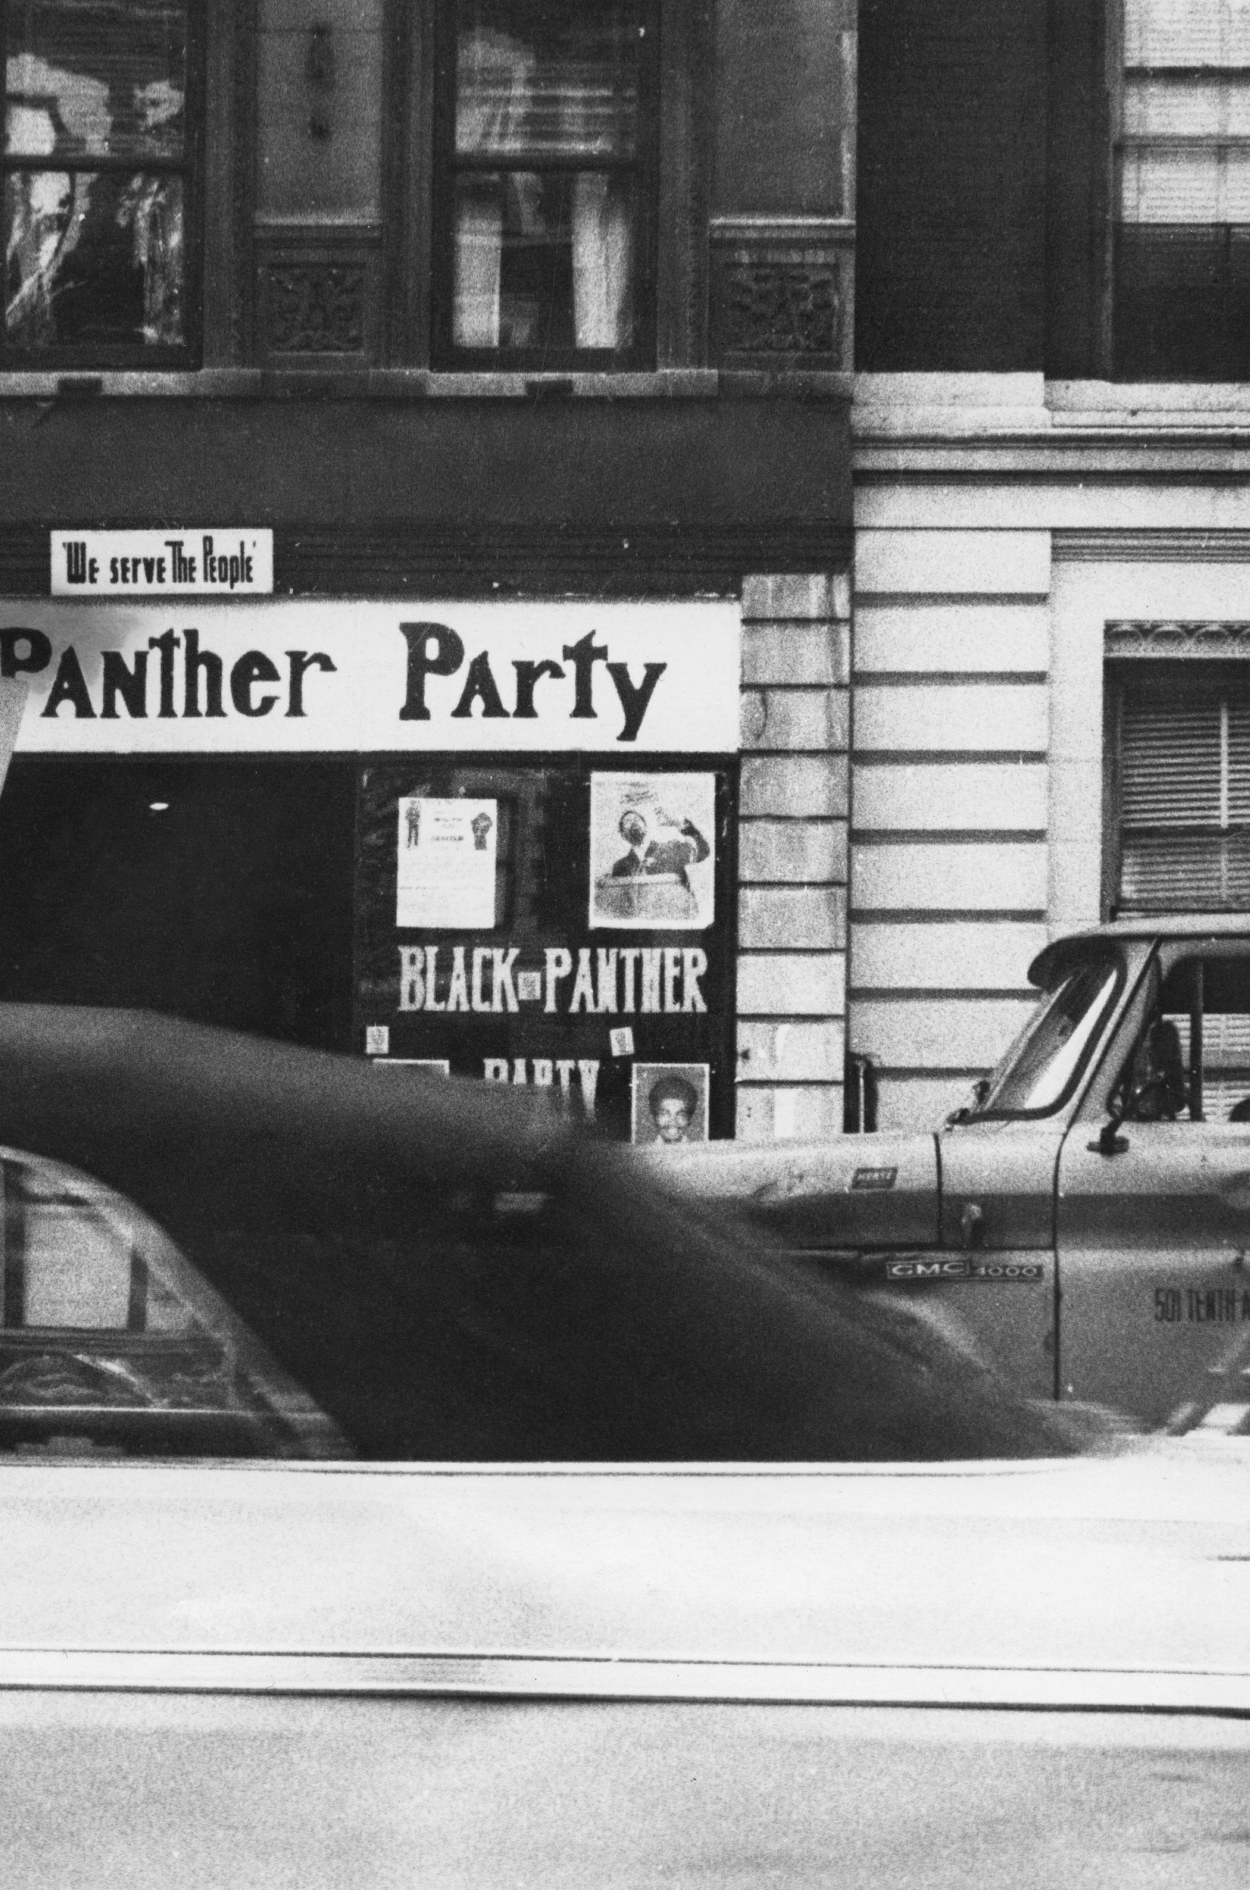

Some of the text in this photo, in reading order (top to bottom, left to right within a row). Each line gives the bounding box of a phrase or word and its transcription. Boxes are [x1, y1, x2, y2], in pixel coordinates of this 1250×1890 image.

[164, 540, 197, 583] The
[397, 945, 708, 1013] BLACK PANTHER
[892, 1262, 1037, 1277] GMC 4000
[1154, 1288, 1182, 1322] 501
